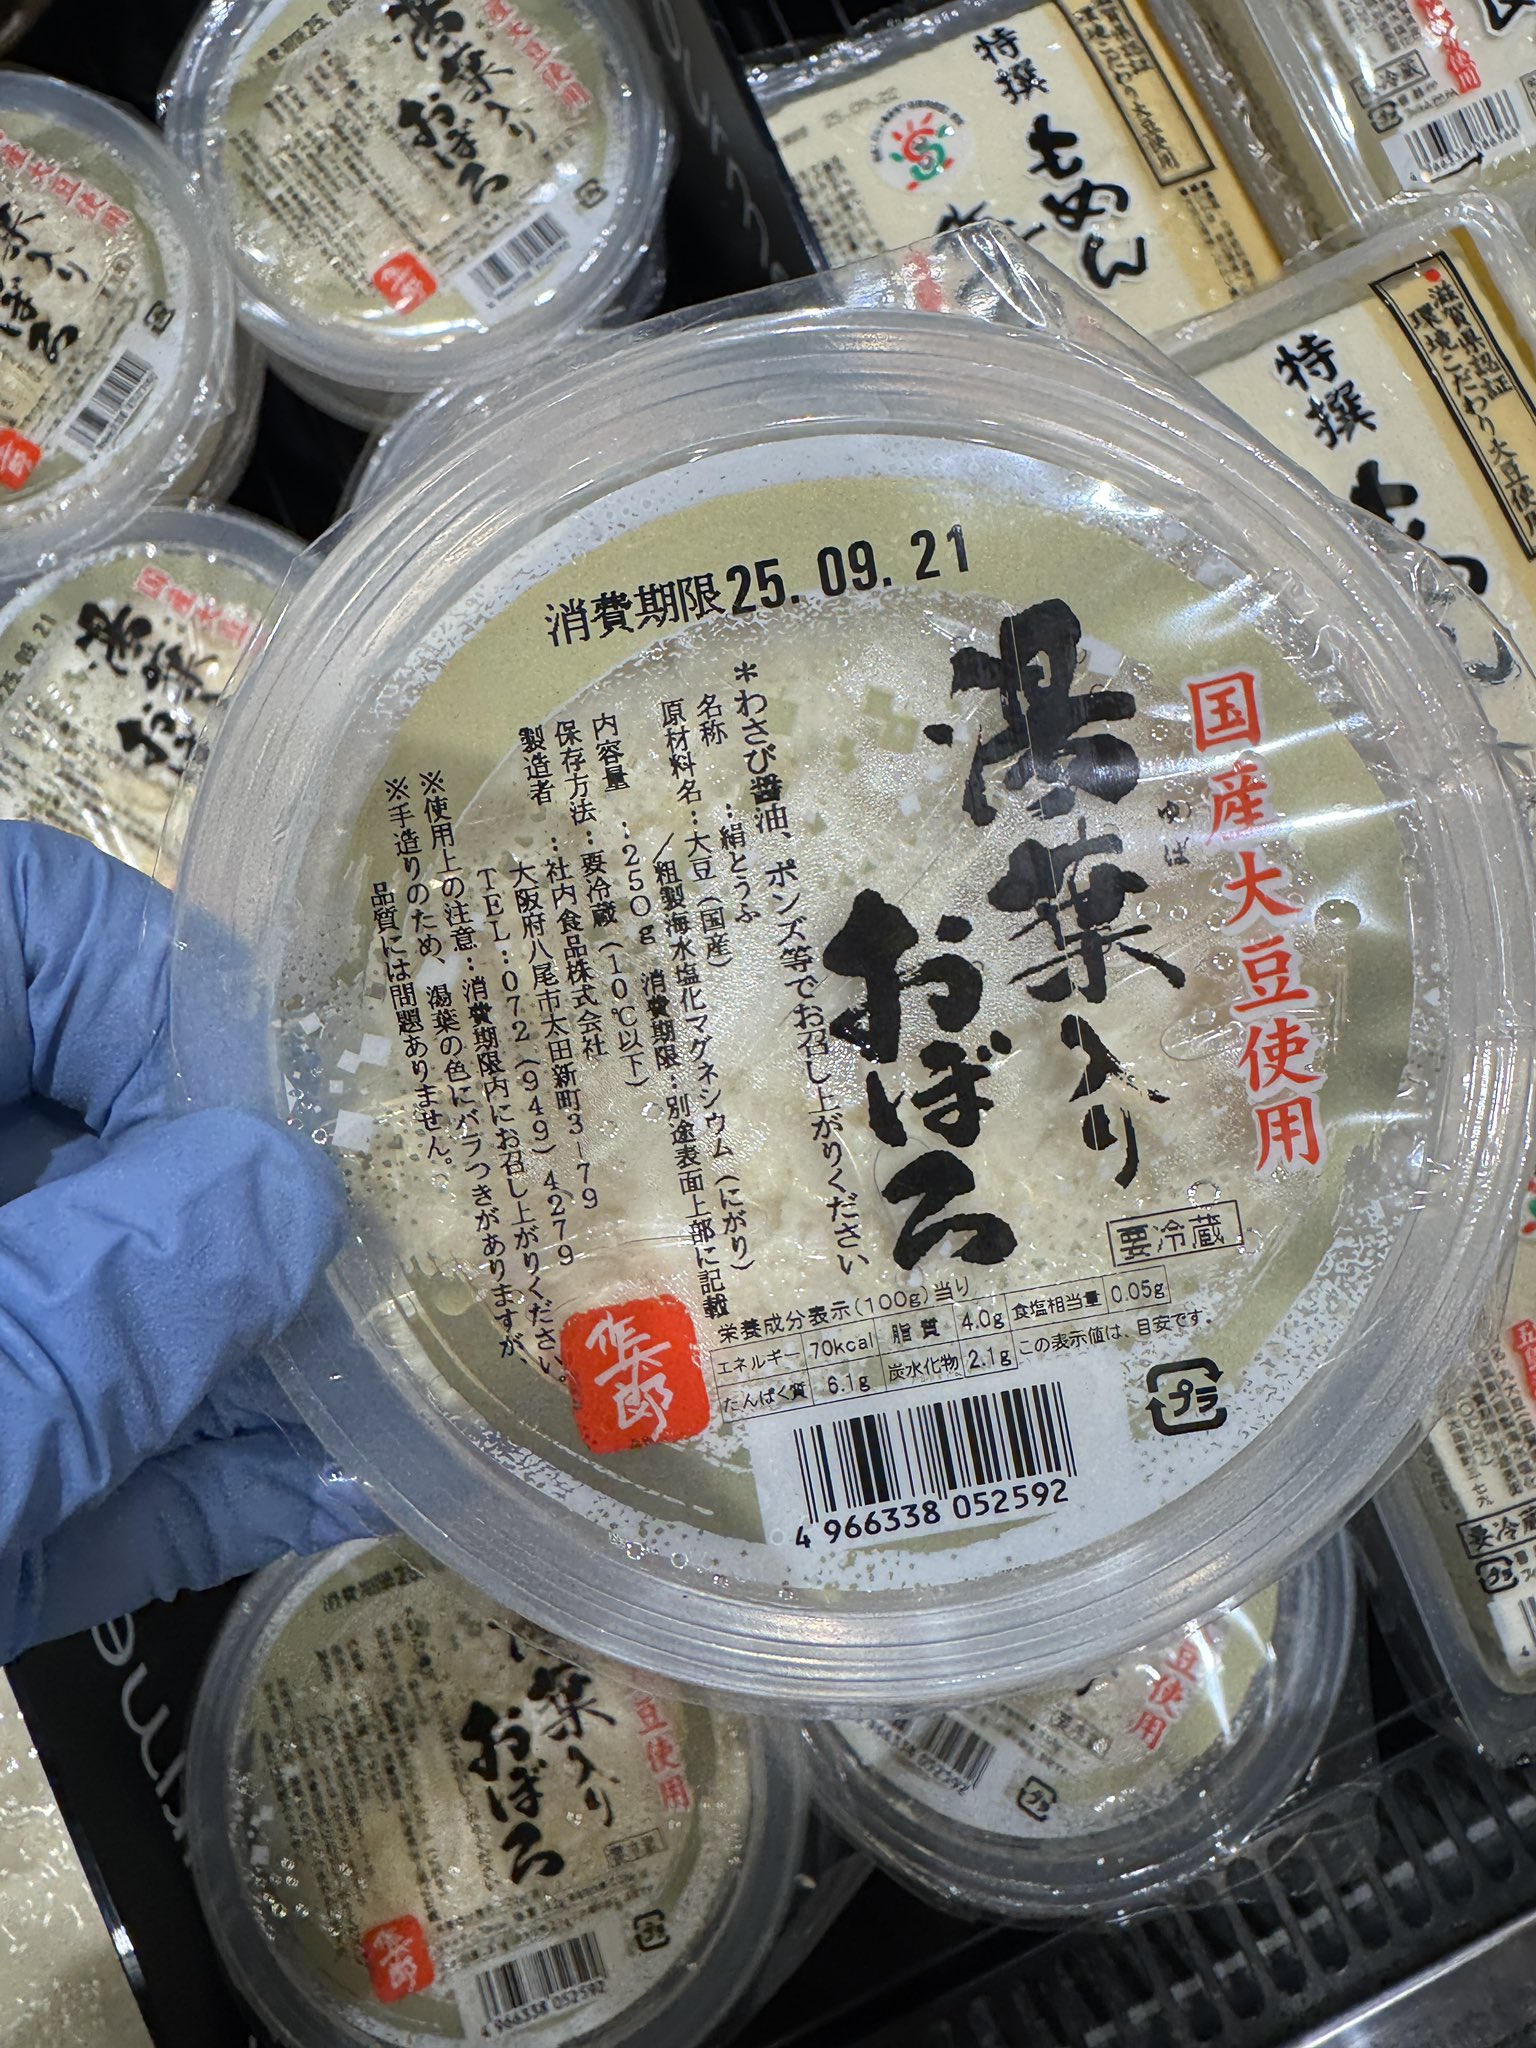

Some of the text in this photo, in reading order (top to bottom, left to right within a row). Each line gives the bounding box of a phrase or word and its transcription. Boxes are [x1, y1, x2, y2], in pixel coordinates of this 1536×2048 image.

[1028, 113, 1149, 289] もめん
[1274, 334, 1377, 450] 特撰
[592, 712, 632, 793] 内容量
[697, 693, 729, 747] 名称
[519, 725, 555, 805] 製造者
[1187, 671, 1328, 1174] 国産大豆使用
[823, 889, 1018, 1270] おぼろ
[1118, 1213, 1225, 1260] 要冷蔵
[718, 1350, 801, 1375] エネルギー
[810, 1333, 874, 1360] 70kcal
[962, 1307, 1006, 1334] 4.0g
[1012, 1290, 1101, 1323] 食塩相当量
[1111, 1280, 1167, 1306] 0.05g
[723, 1381, 809, 1411] たんぱく質
[827, 1372, 871, 1397] 6.1g
[888, 1356, 960, 1383] 炭水化物
[968, 1346, 1013, 1370] 2.1g
[953, 1478, 1069, 1520] 052592
[460, 1697, 565, 1885] おぼろ
